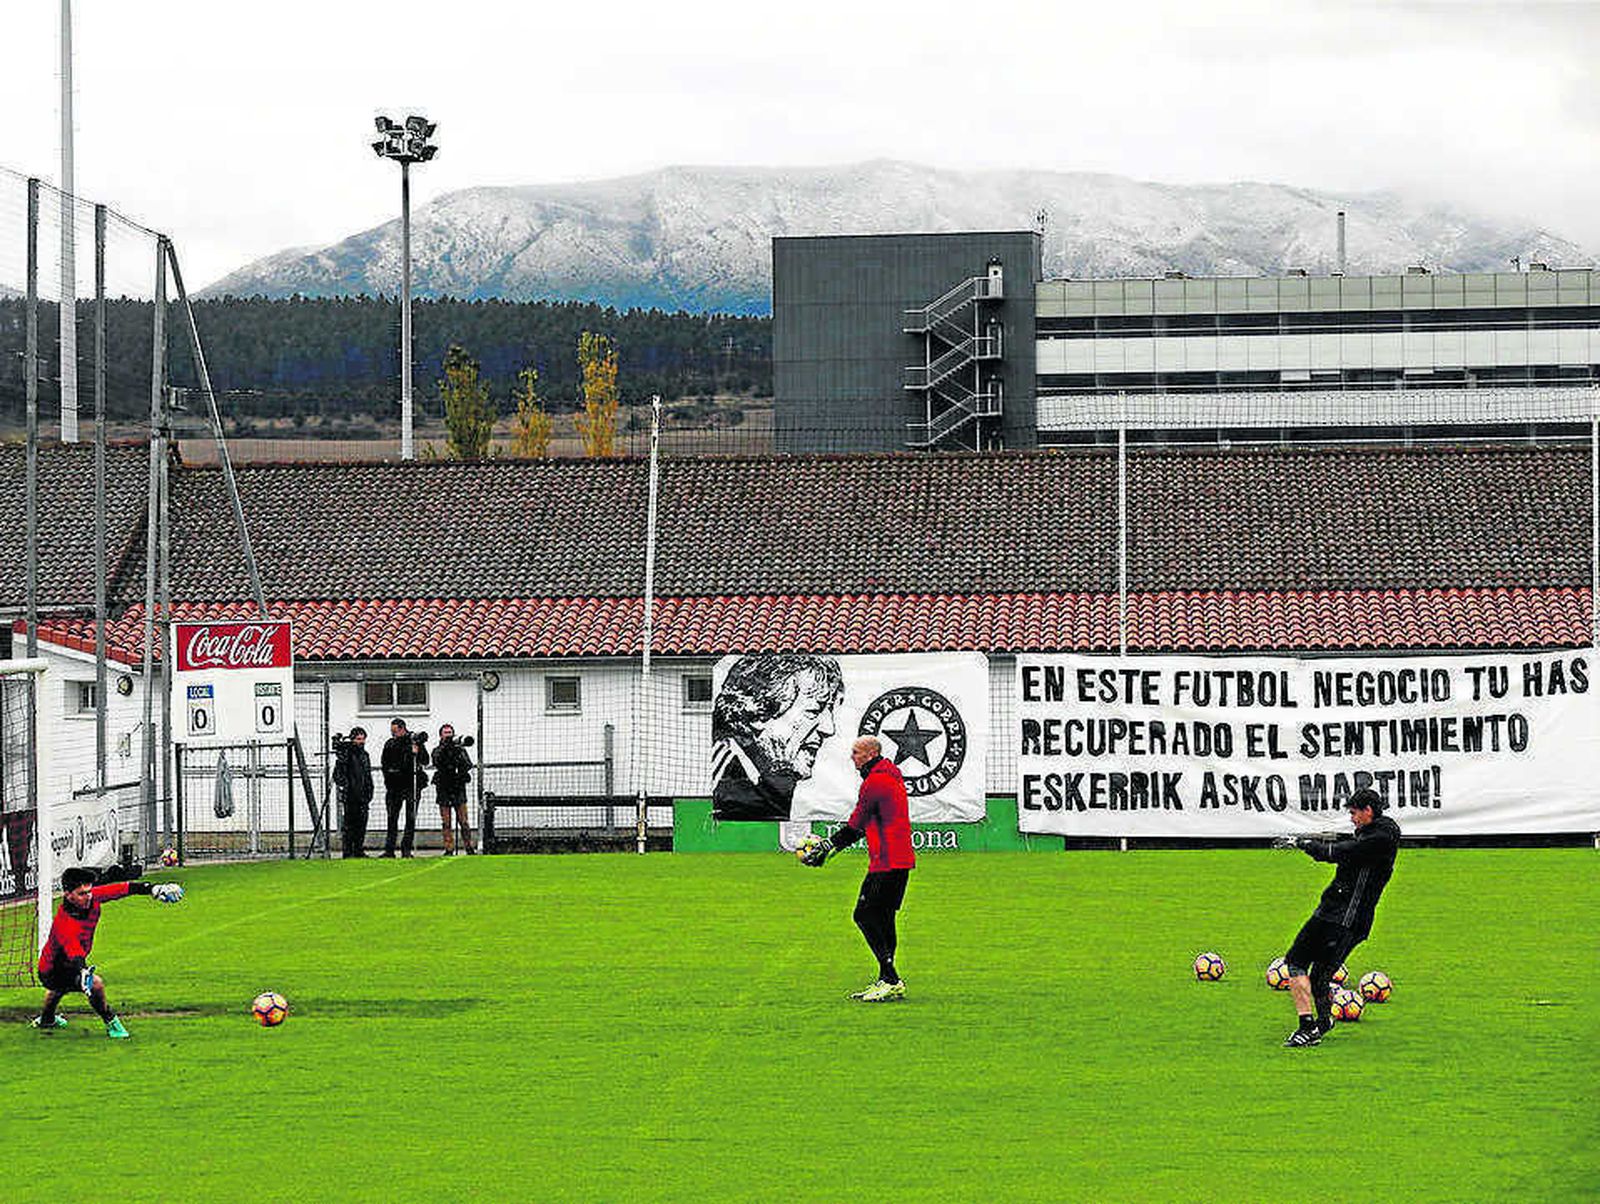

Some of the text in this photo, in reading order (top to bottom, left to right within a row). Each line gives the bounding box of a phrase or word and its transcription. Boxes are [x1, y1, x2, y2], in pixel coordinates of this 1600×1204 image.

[186, 625, 280, 668] Coca-Cola
[1021, 657, 1590, 708] EN ESTE FUTBOL NEGOCIO TU HAS
[194, 708, 208, 730] 0
[261, 705, 275, 726] 0
[863, 694, 907, 734] NDAR
[1021, 713, 1529, 760] RECUPERADO EL SENTIMIENTO
[1023, 765, 1441, 812] ESKERRIK ASKO MARTIN!
